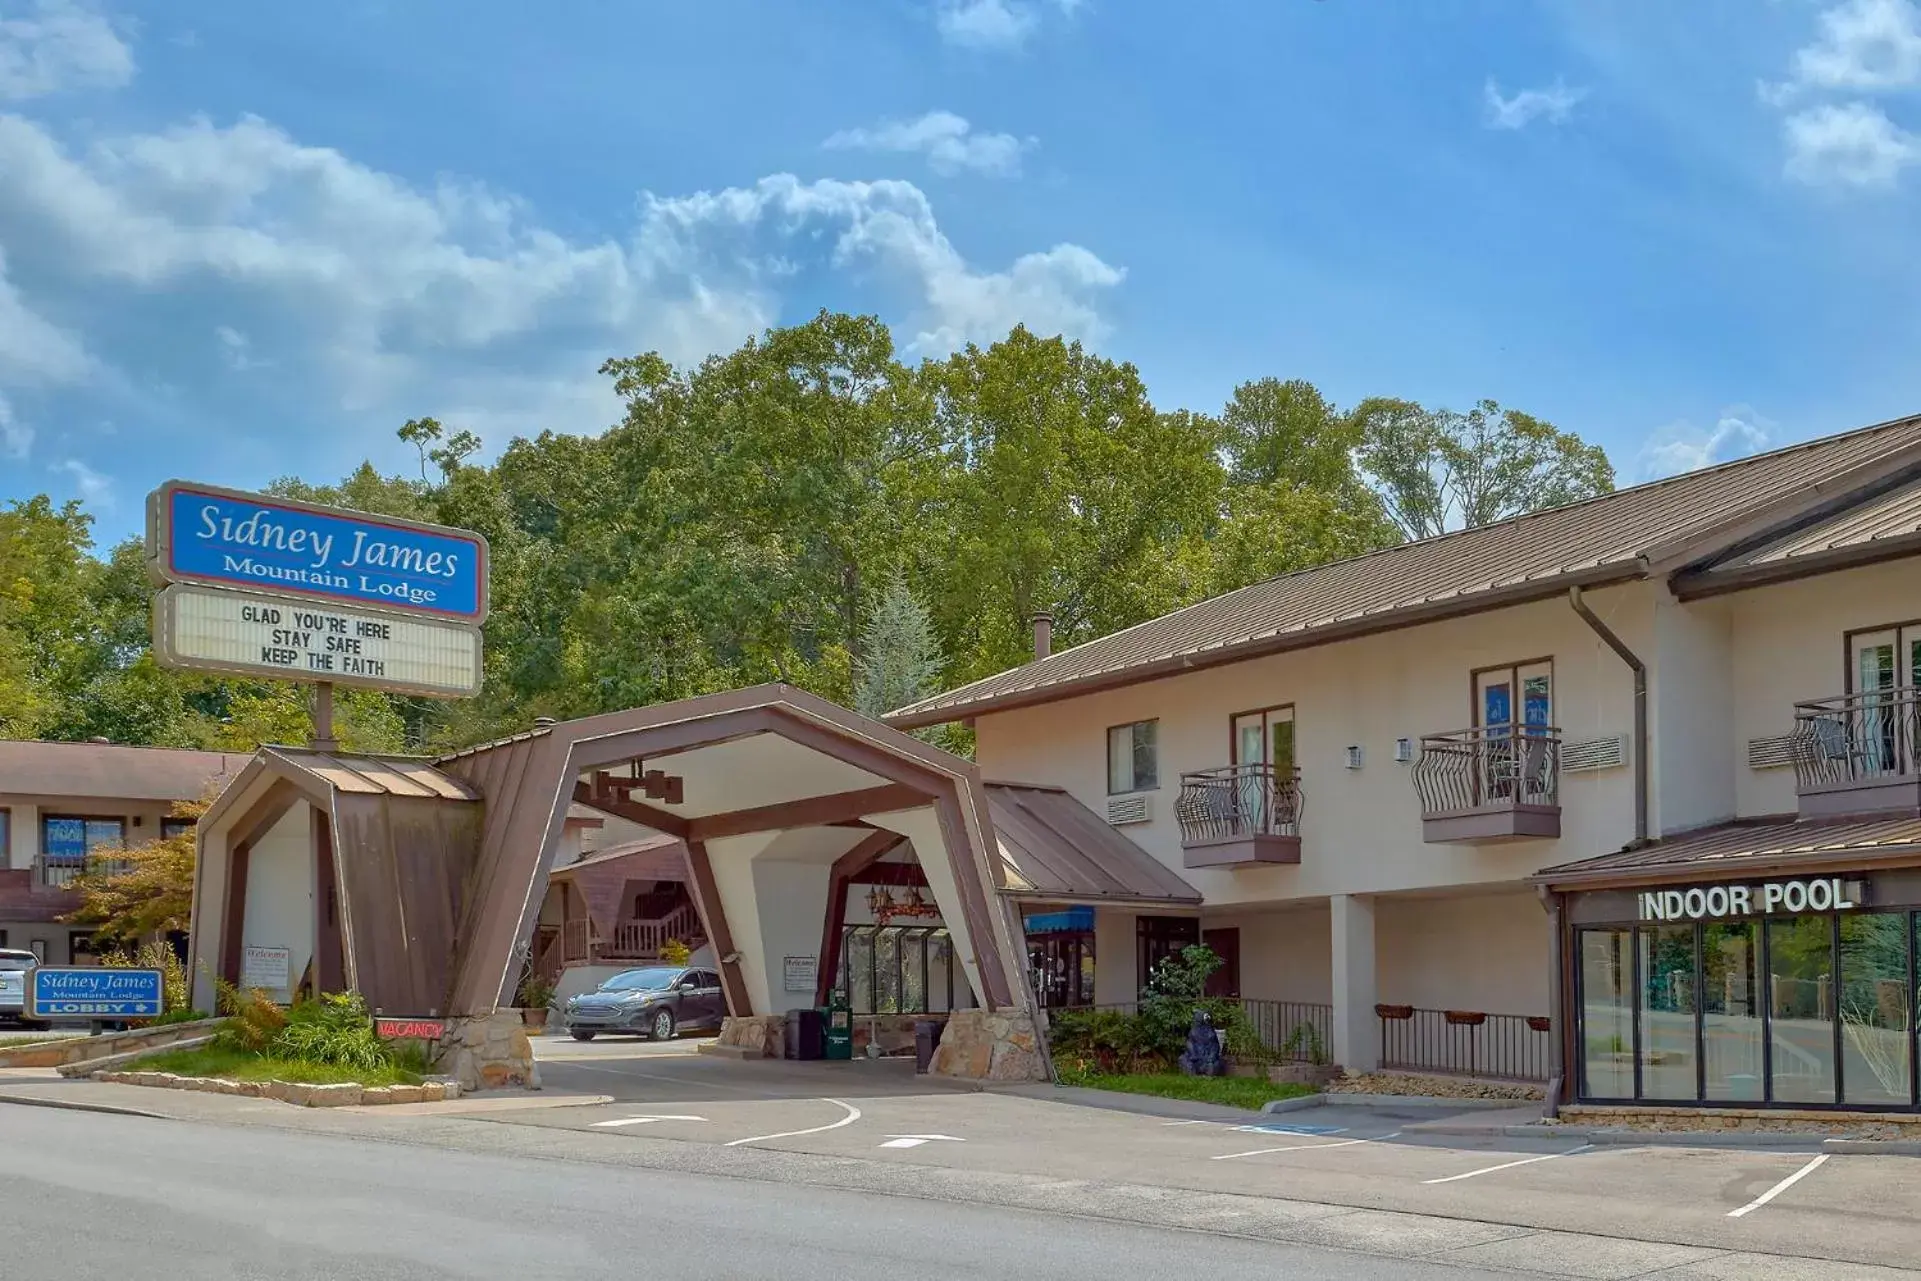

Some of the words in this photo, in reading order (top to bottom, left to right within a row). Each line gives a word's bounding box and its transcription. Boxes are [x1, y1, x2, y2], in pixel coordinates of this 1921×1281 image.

[196, 505, 334, 568] Sidney
[341, 530, 458, 578] James
[223, 555, 351, 589] Mountain
[358, 575, 438, 604] Lodge
[241, 606, 281, 625] GLAD
[294, 612, 348, 634] YOU'RE
[356, 620, 391, 640] HERE
[271, 629, 312, 648] STAY
[325, 636, 361, 654] SAFE
[261, 646, 298, 665] KEEP
[306, 652, 334, 670] THE
[343, 657, 385, 676] FAITH
[1637, 885, 1751, 921] INDOOR
[1764, 878, 1854, 914] POOL
[41, 973, 100, 992] Sidney
[102, 975, 155, 990] James
[52, 991, 106, 999] Mountain
[110, 991, 145, 1000] Lodge
[49, 1003, 126, 1013] LOBBY
[380, 1022, 445, 1037] VACANCY
